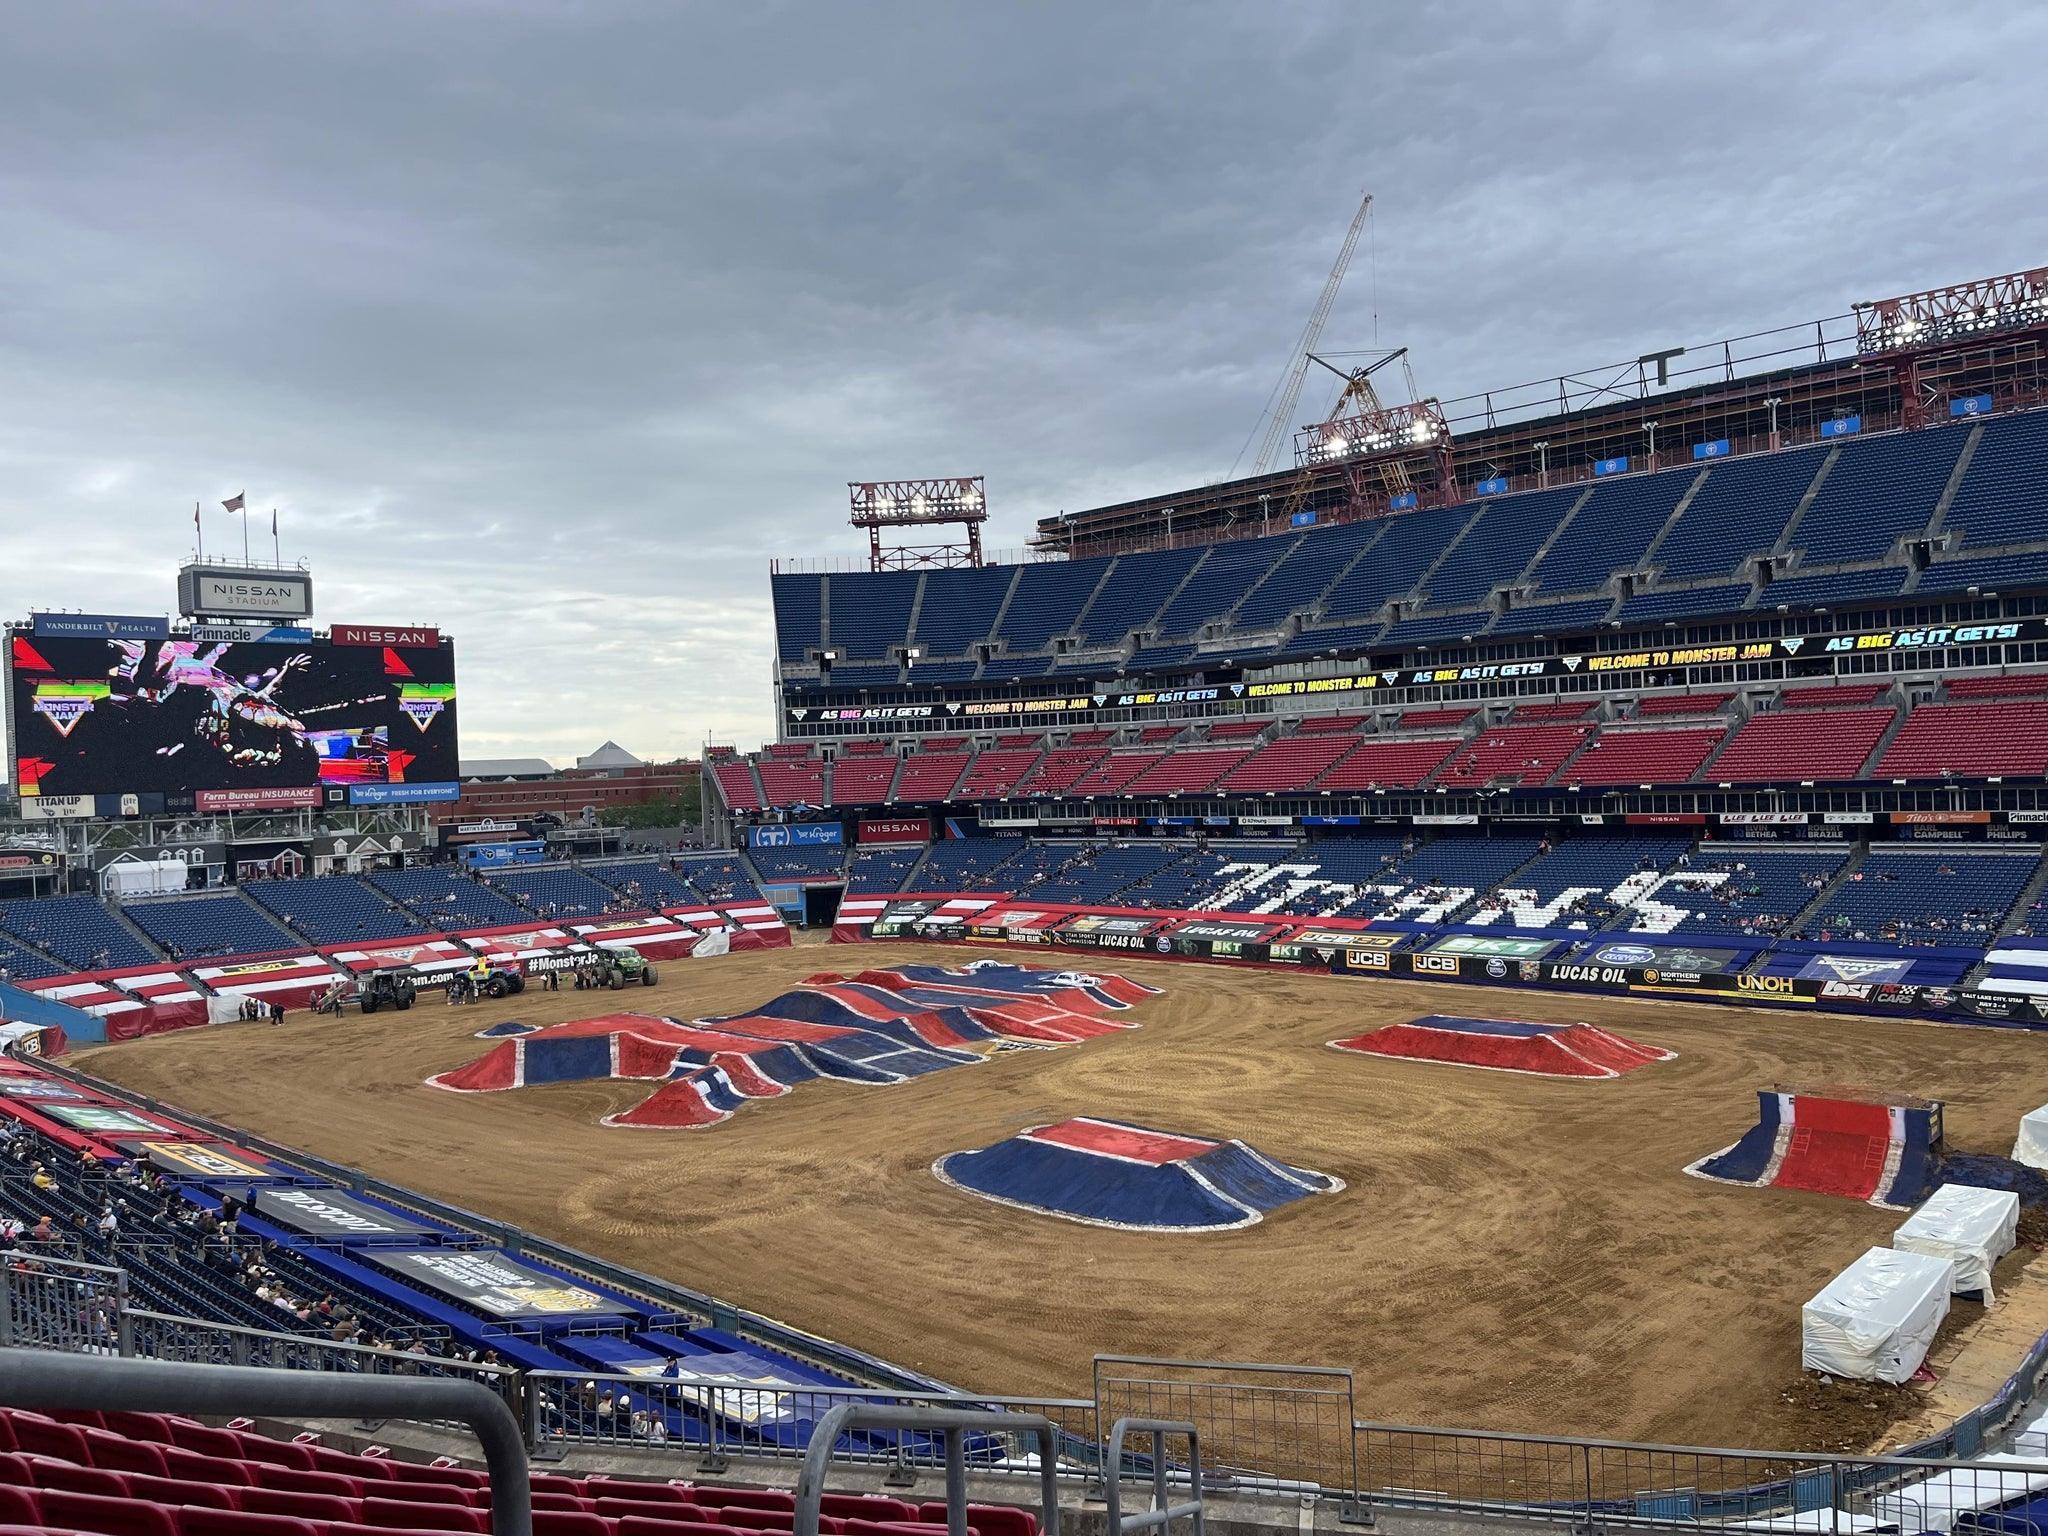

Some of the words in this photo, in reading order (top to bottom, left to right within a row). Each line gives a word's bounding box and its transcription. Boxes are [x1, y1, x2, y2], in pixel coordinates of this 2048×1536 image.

[214, 584, 292, 598] NISSAN
[227, 596, 280, 606] STADIUM
[45, 622, 104, 631] VANDERBILT
[121, 625, 157, 633] HEALTH
[193, 625, 251, 641] Pinnacle
[346, 630, 426, 644] NISSAN
[1825, 637, 1855, 651] AS
[1856, 633, 1893, 649] BIG
[1894, 631, 1926, 647] AS
[1928, 629, 1952, 644] IT
[1954, 624, 2018, 642] GETS!
[1588, 655, 1650, 671] WELCOME
[1652, 652, 1670, 666] TO
[1671, 646, 1737, 665] MONSTER
[1739, 643, 1772, 658] JAM
[1412, 672, 1433, 683] AS
[1434, 669, 1459, 681] BIG
[1459, 668, 1481, 679] AS
[1482, 666, 1499, 678] IT
[1500, 663, 1545, 677] GETS!
[1248, 682, 1293, 697] WELCOME
[1293, 681, 1306, 693] TO
[1307, 677, 1352, 693] MONSTER
[1353, 675, 1377, 689] JAM
[1118, 695, 1135, 705] AS
[1135, 694, 1156, 704] BIG
[1156, 693, 1173, 703] AS
[1172, 691, 1186, 702] IT
[1186, 689, 1218, 701] GETS!
[33, 703, 95, 712] MONSTER
[399, 703, 445, 712] MONSTER
[820, 710, 838, 719] AS
[839, 709, 862, 719] BIG
[863, 708, 880, 718] AS
[880, 707, 895, 718] IT
[896, 706, 932, 717] GETS!
[965, 702, 1010, 715] WELCOME
[1011, 701, 1023, 712] TO
[1024, 699, 1067, 712] MONSTER
[1067, 698, 1089, 709] JAM
[52, 712, 77, 720] JAM
[412, 711, 433, 719] JAM
[203, 793, 226, 801] Farm
[228, 791, 260, 800] Bureau
[261, 789, 315, 799] INSURANCE
[364, 787, 388, 801] Kroger
[35, 797, 65, 807] TITAN
[67, 796, 81, 806] UP
[123, 797, 137, 806] Lite
[63, 808, 77, 816] Lite
[1906, 813, 1934, 823] Tito's
[2010, 812, 2048, 821] Pinnacl
[459, 825, 480, 833] MARTIN'S
[867, 823, 920, 833] NISSAN
[809, 826, 838, 843] Kroger
[1914, 831, 1963, 839] CAMPBELL
[1987, 831, 2027, 839] PHILLIPS
[1177, 925, 1231, 937] LUCAS
[1008, 934, 1025, 942] SUPER
[1099, 934, 1129, 948] LUCAS
[1130, 936, 1145, 948] OIL
[1212, 940, 1242, 954] BKT
[1269, 945, 1302, 958] BKT
[528, 952, 599, 972] #MonsterJa
[1350, 953, 1386, 966] JCB
[1416, 956, 1457, 970] JCB
[1817, 959, 1902, 970] MONSTER
[1551, 964, 1600, 983] LUCAS
[1601, 967, 1627, 984] OIL
[1837, 965, 1874, 973] JAM
[1660, 971, 1700, 980] NORTHERN
[1736, 975, 1794, 992] UNOH
[1881, 984, 1899, 994] RC
[1877, 993, 1914, 1004] CARS
